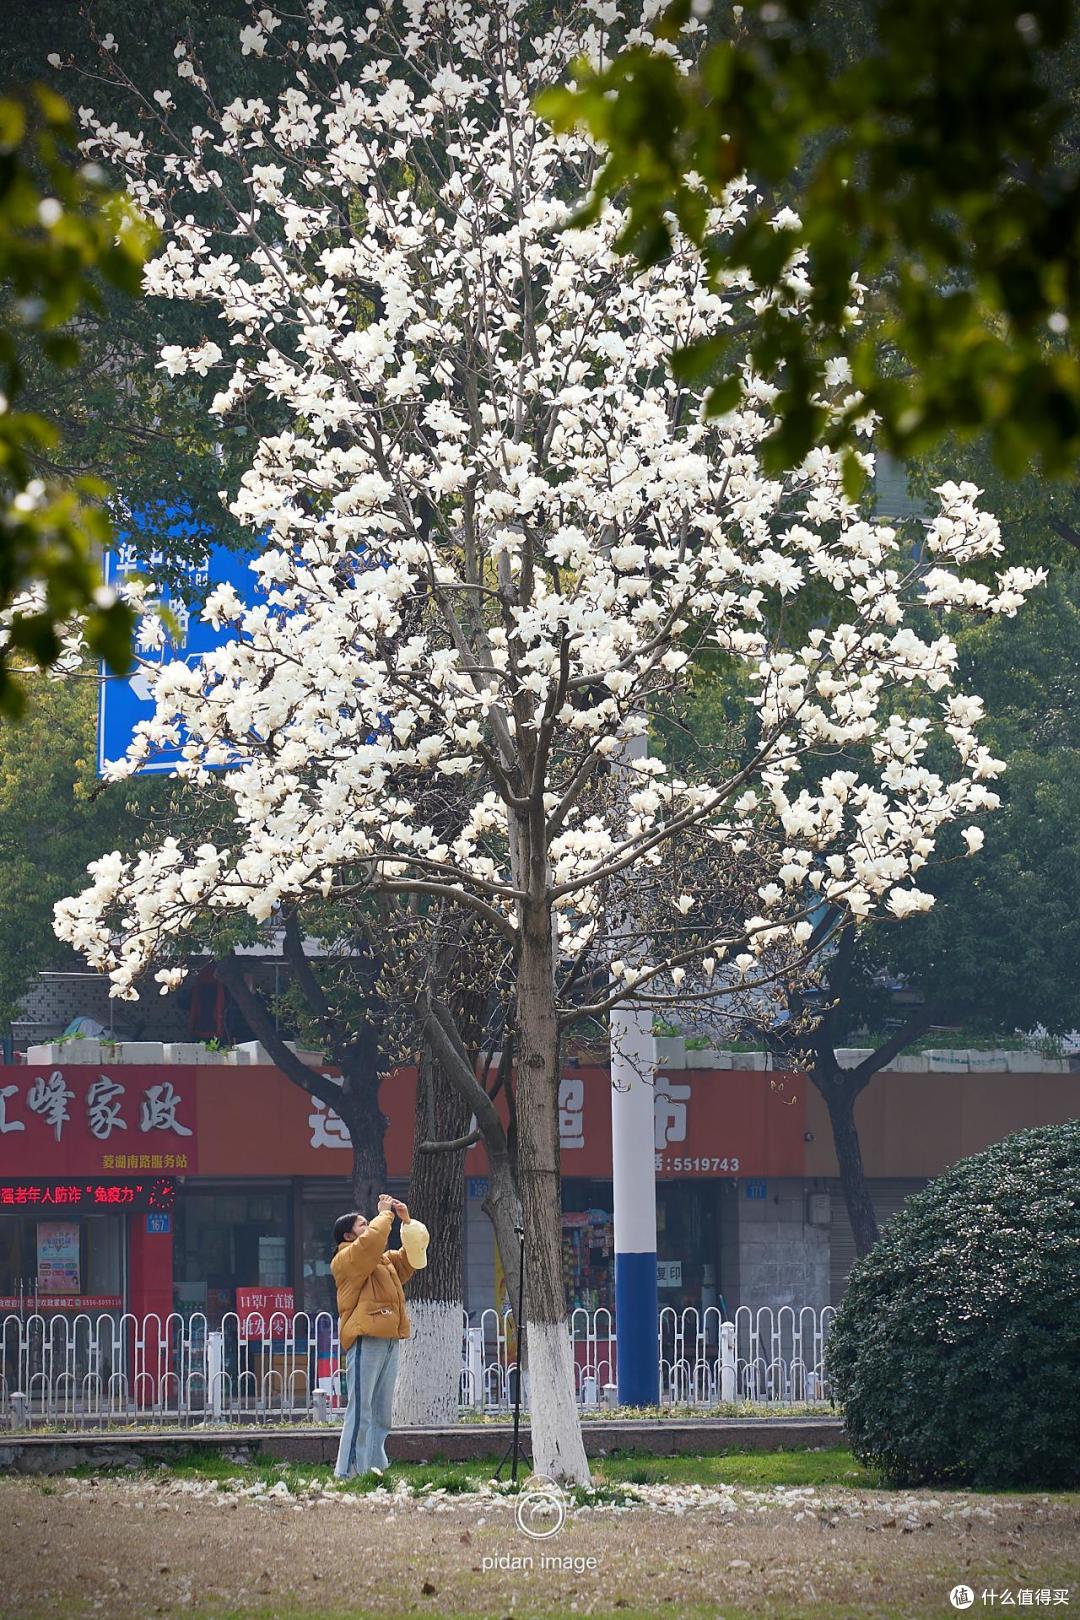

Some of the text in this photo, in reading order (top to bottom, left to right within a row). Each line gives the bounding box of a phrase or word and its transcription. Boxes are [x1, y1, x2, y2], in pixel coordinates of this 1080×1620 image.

[103, 1154, 188, 1169] 菱湖南路服务站
[151, 1219, 165, 1232] 167
[656, 1264, 681, 1280] 复印
[240, 1293, 294, 1310] 口罩厂直销
